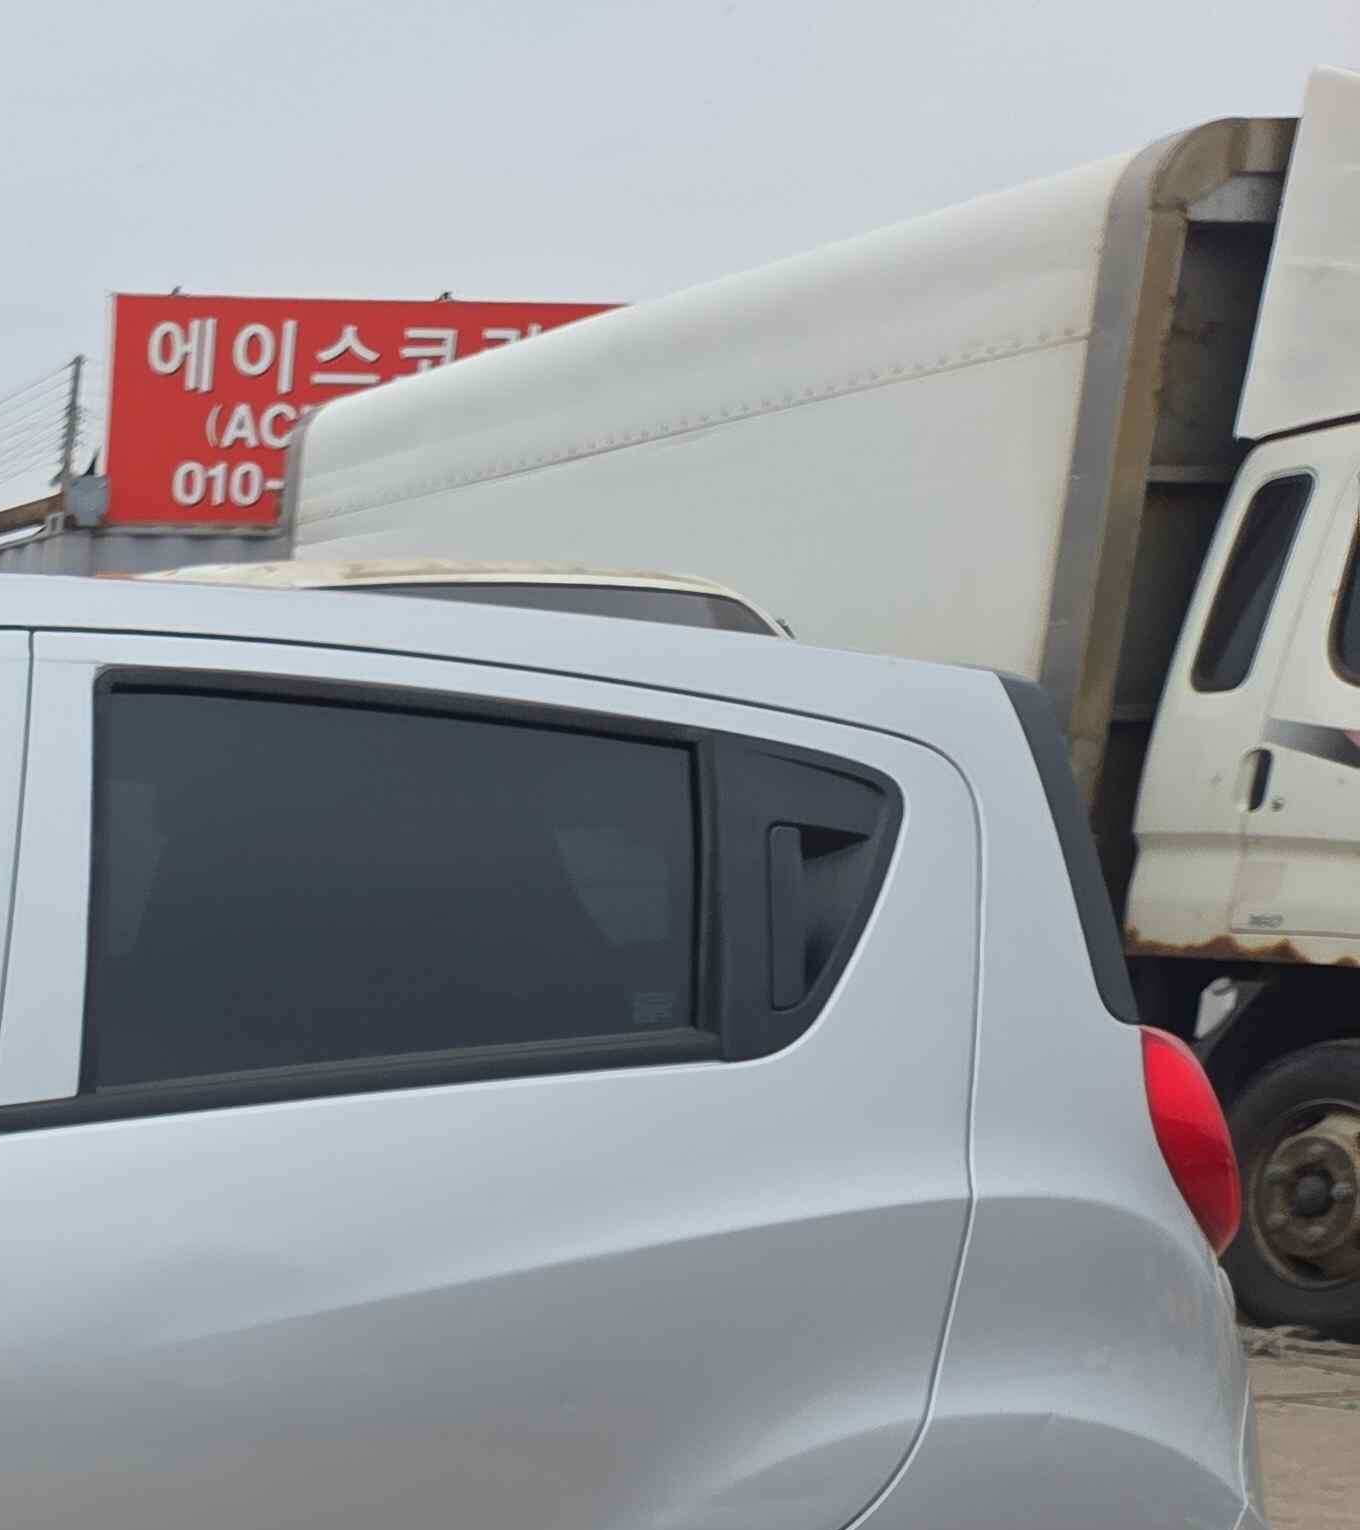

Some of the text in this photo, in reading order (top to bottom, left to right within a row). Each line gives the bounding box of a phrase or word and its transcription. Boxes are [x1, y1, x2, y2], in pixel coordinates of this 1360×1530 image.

[148, 317, 542, 394] 에이스코
[205, 402, 316, 449] (AC
[172, 461, 284, 507] 010-
